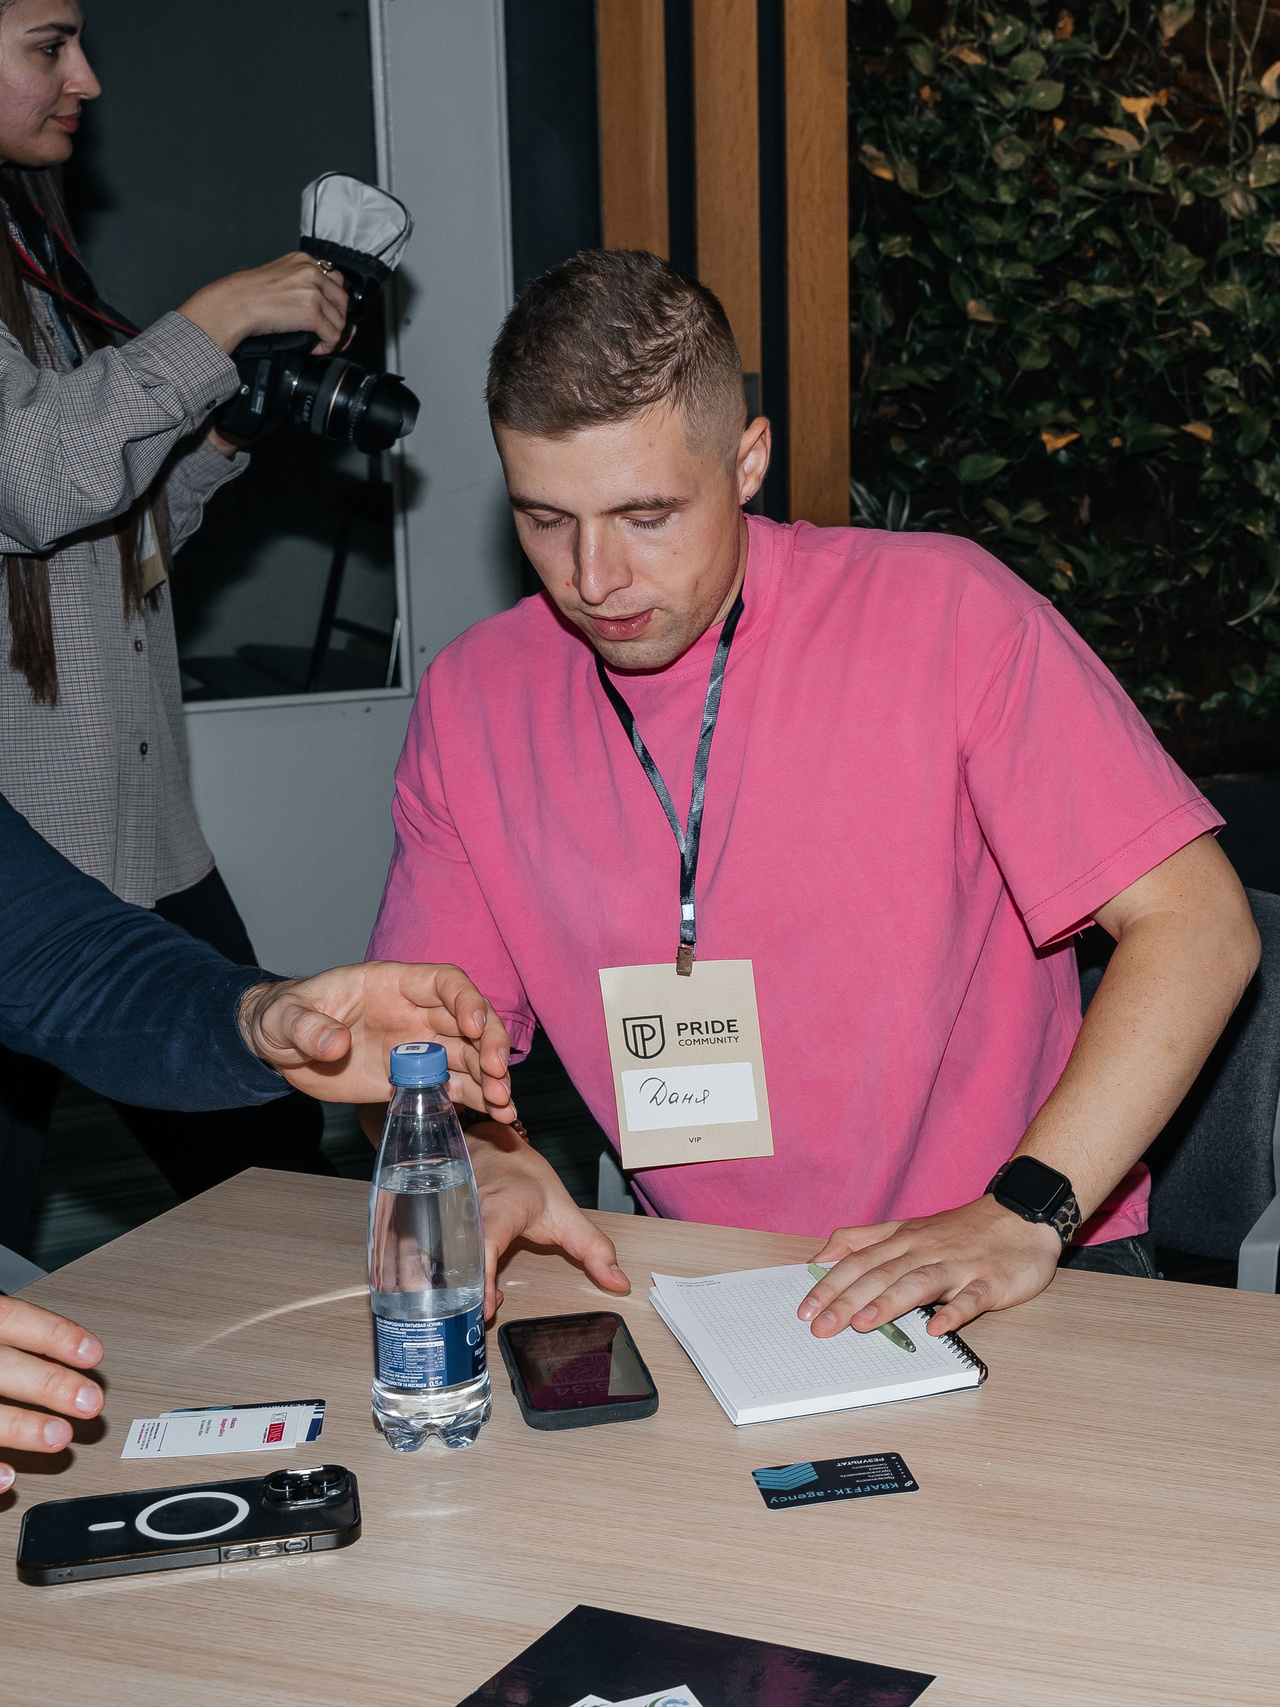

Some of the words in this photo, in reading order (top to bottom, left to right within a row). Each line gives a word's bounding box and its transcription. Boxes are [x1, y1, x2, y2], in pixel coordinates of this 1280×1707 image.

[676, 1019, 739, 1037] PRIDE
[678, 1035, 740, 1047] COMMUNITY
[639, 1077, 710, 1106] Даня
[688, 1136, 702, 1144] VIP
[836, 1457, 885, 1467] РЕЗУЛЬТАТ
[770, 1482, 899, 1504] KRAFFIK.agency
